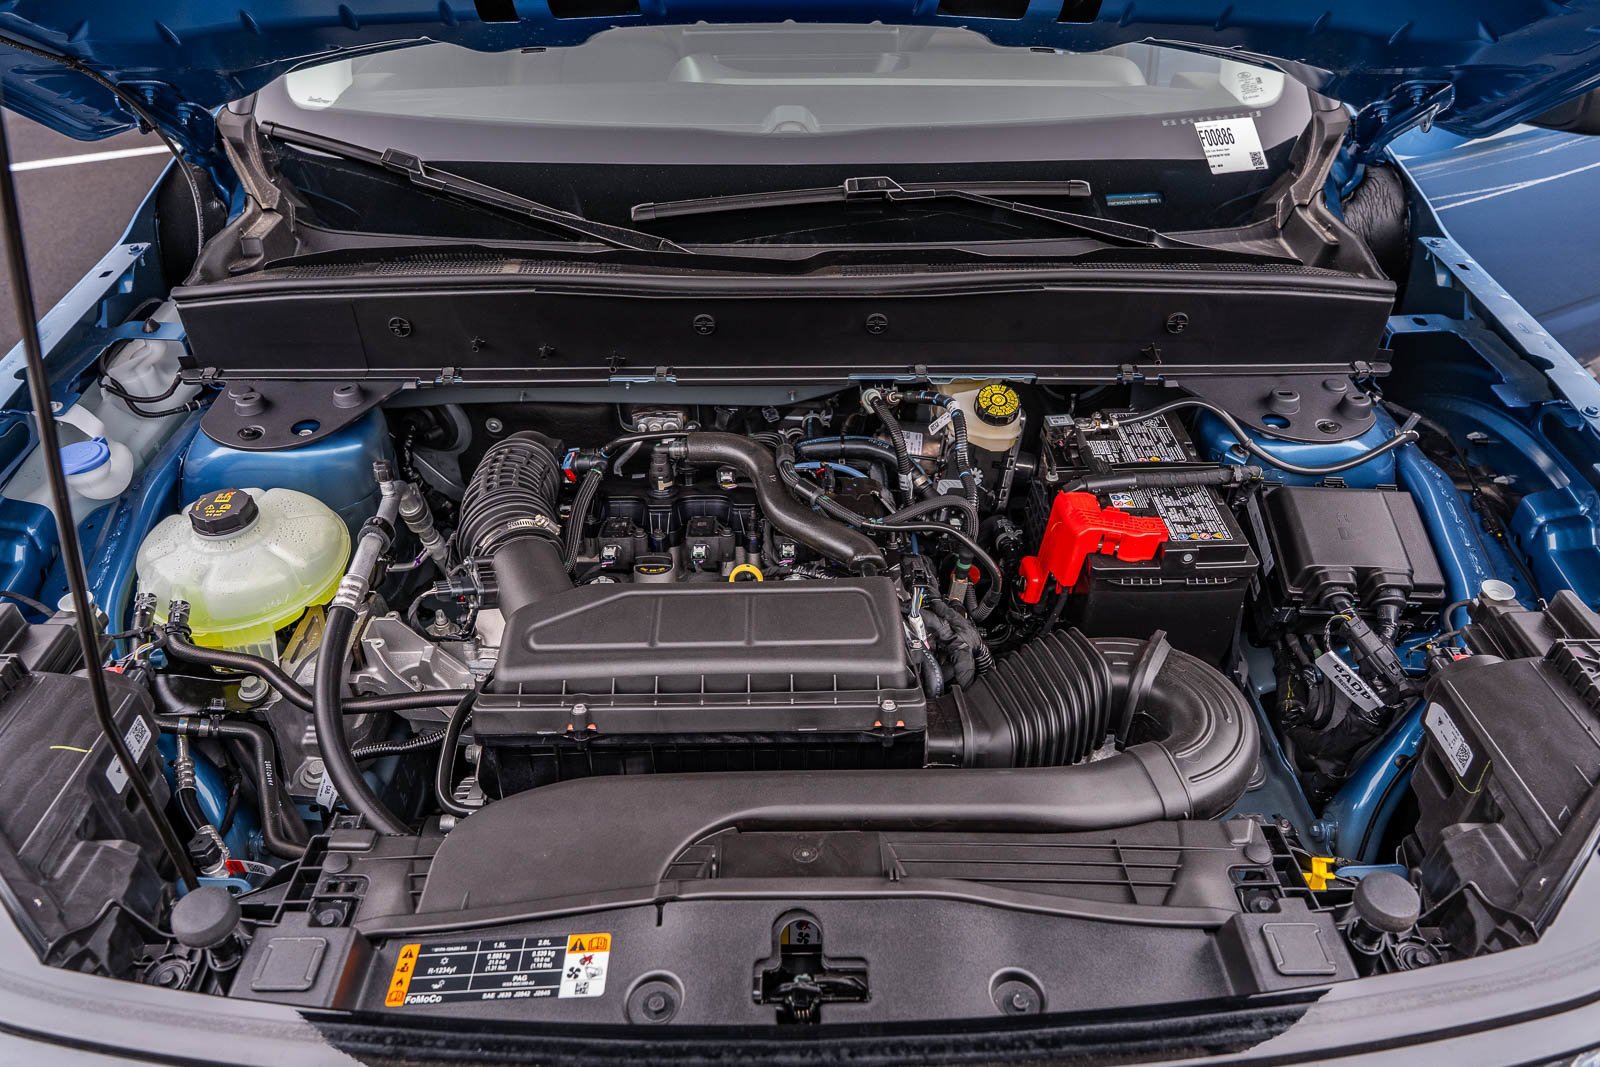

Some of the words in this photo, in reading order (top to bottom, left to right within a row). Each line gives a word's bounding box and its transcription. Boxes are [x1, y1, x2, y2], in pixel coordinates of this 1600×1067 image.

[1197, 127, 1235, 147] F00886
[493, 941, 507, 949] 1.5L
[537, 939, 552, 947] 2.0L
[502, 952, 511, 960] kg
[547, 949, 556, 958] kg
[427, 966, 457, 975] R-1234yf
[512, 974, 528, 982] PAG
[404, 994, 442, 1004] FoMoCo
[481, 992, 496, 1000] SAE
